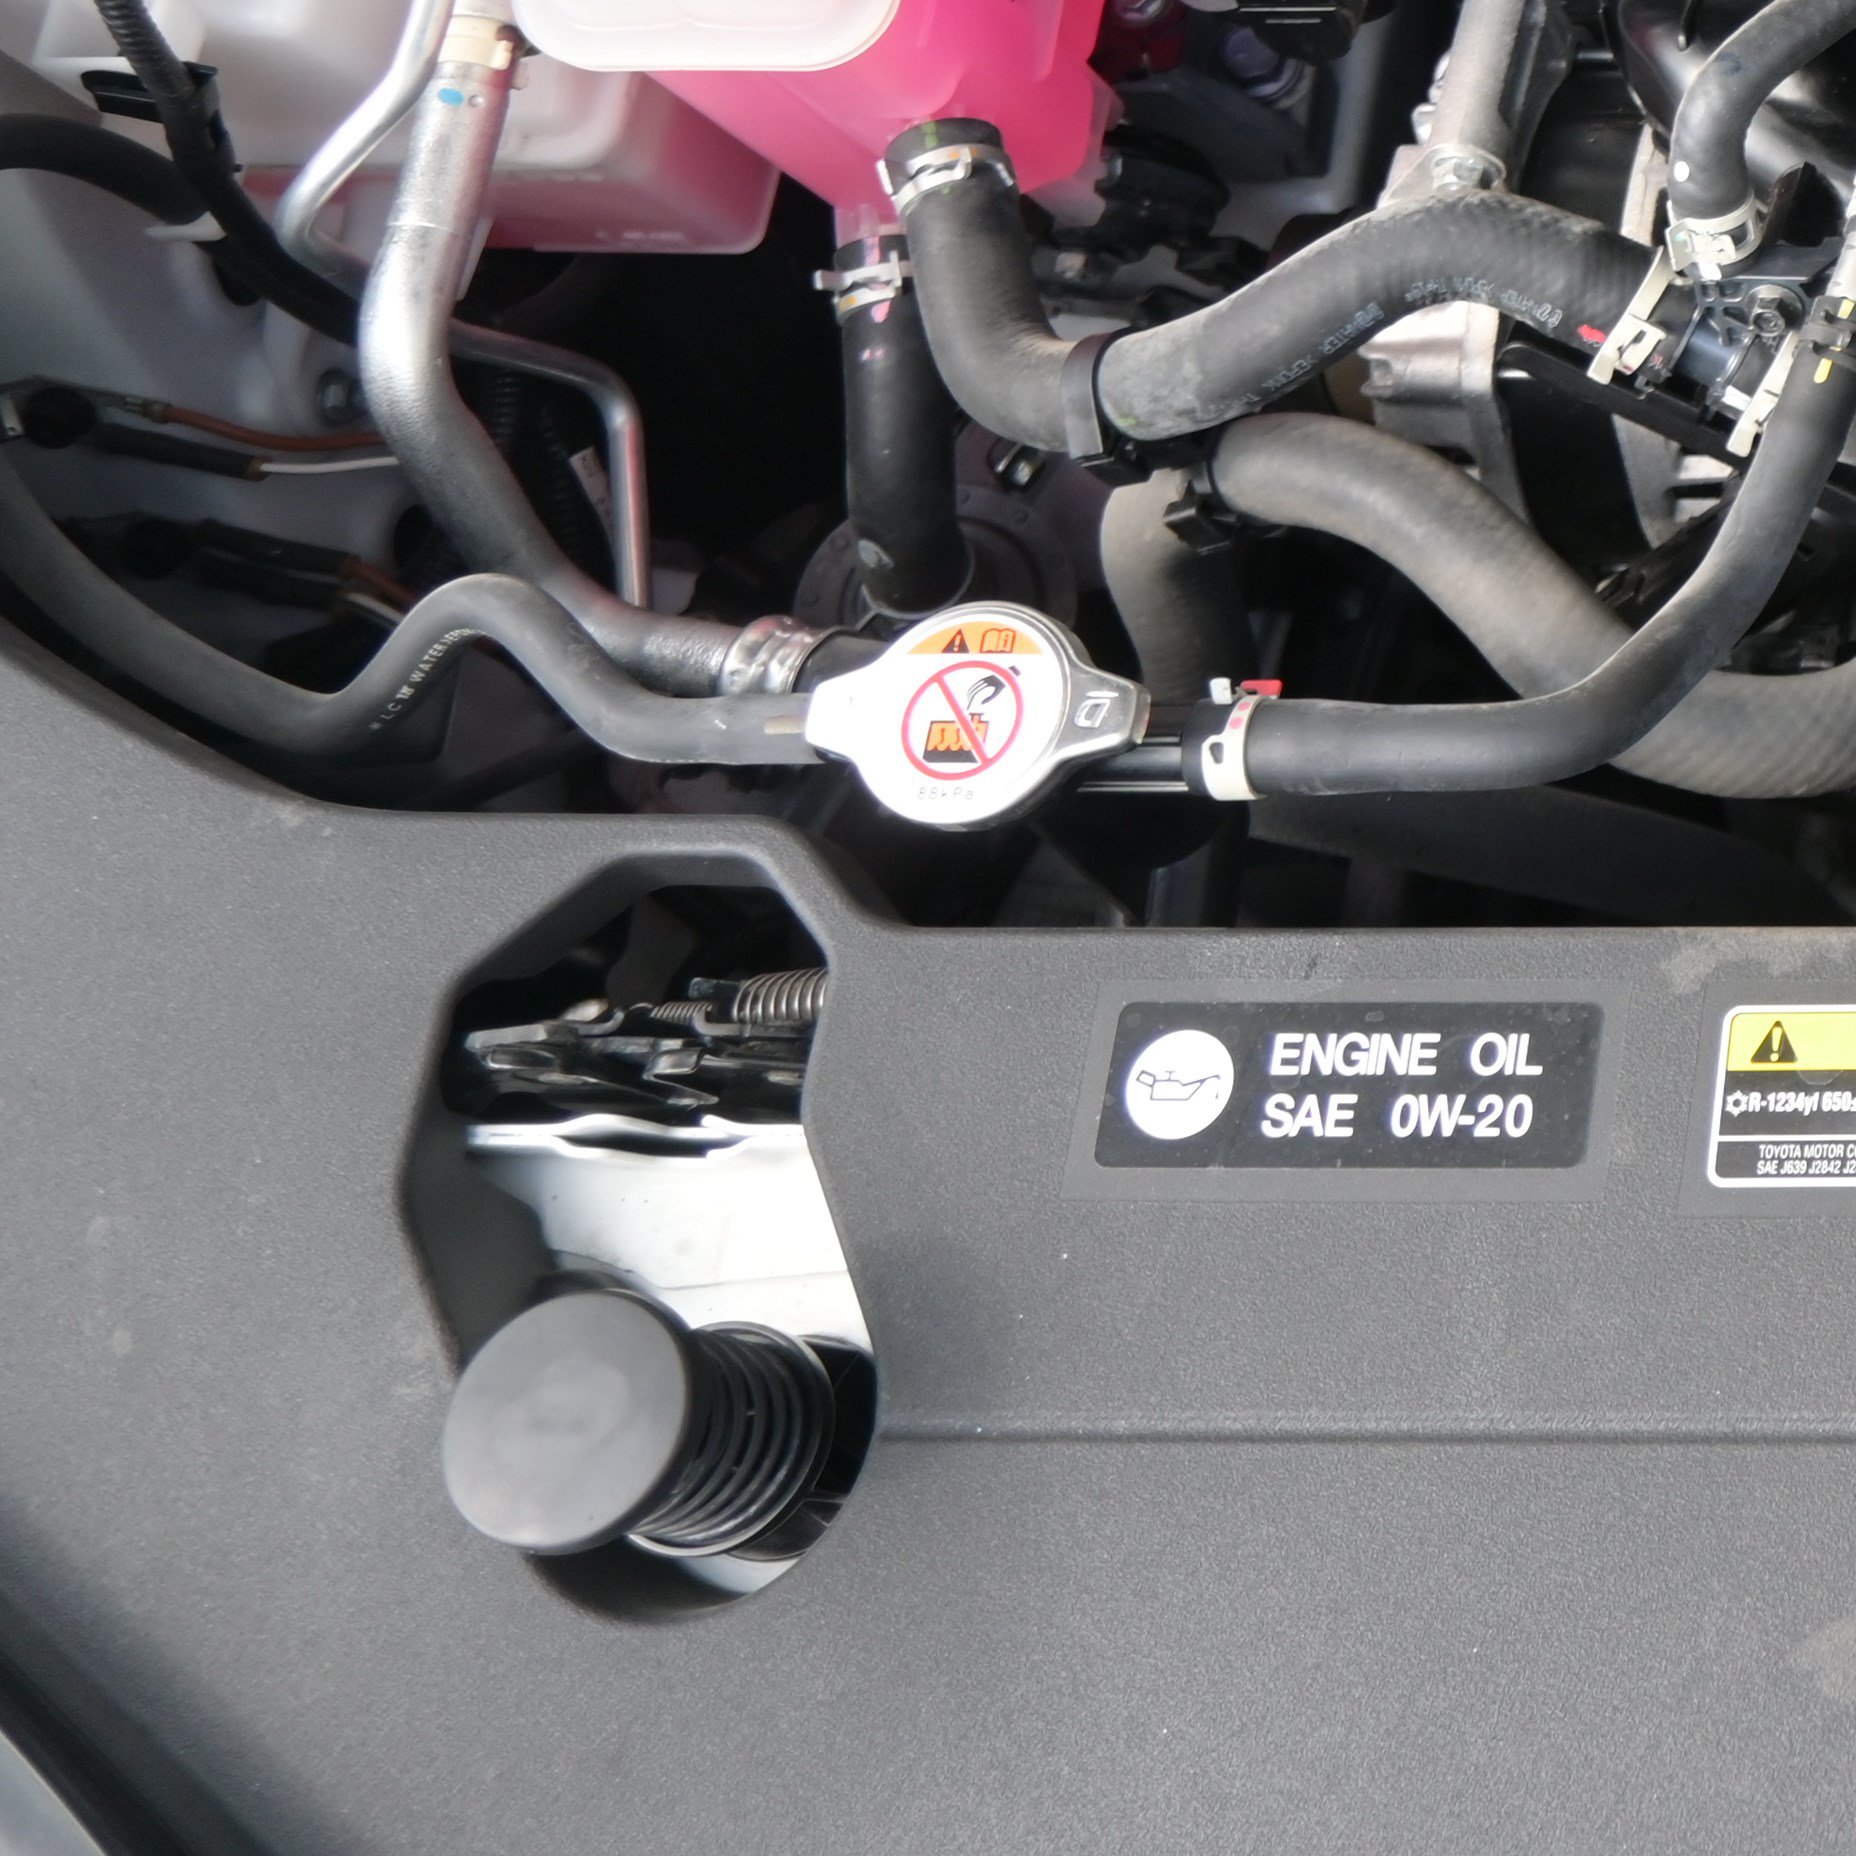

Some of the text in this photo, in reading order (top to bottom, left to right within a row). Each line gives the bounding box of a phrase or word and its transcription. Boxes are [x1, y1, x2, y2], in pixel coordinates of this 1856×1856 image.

[1269, 1031, 1544, 1076] ENGINE OIL
[1260, 1093, 1534, 1139] SAE 0W-20
[1748, 1091, 1819, 1116] R-1234yf
[1758, 1144, 1801, 1159] TOYOTA
[1803, 1144, 1844, 1159] MOTOR
[1757, 1160, 1778, 1175] SAE
[1780, 1159, 1807, 1175] J639
[1809, 1159, 1841, 1175] J2842
